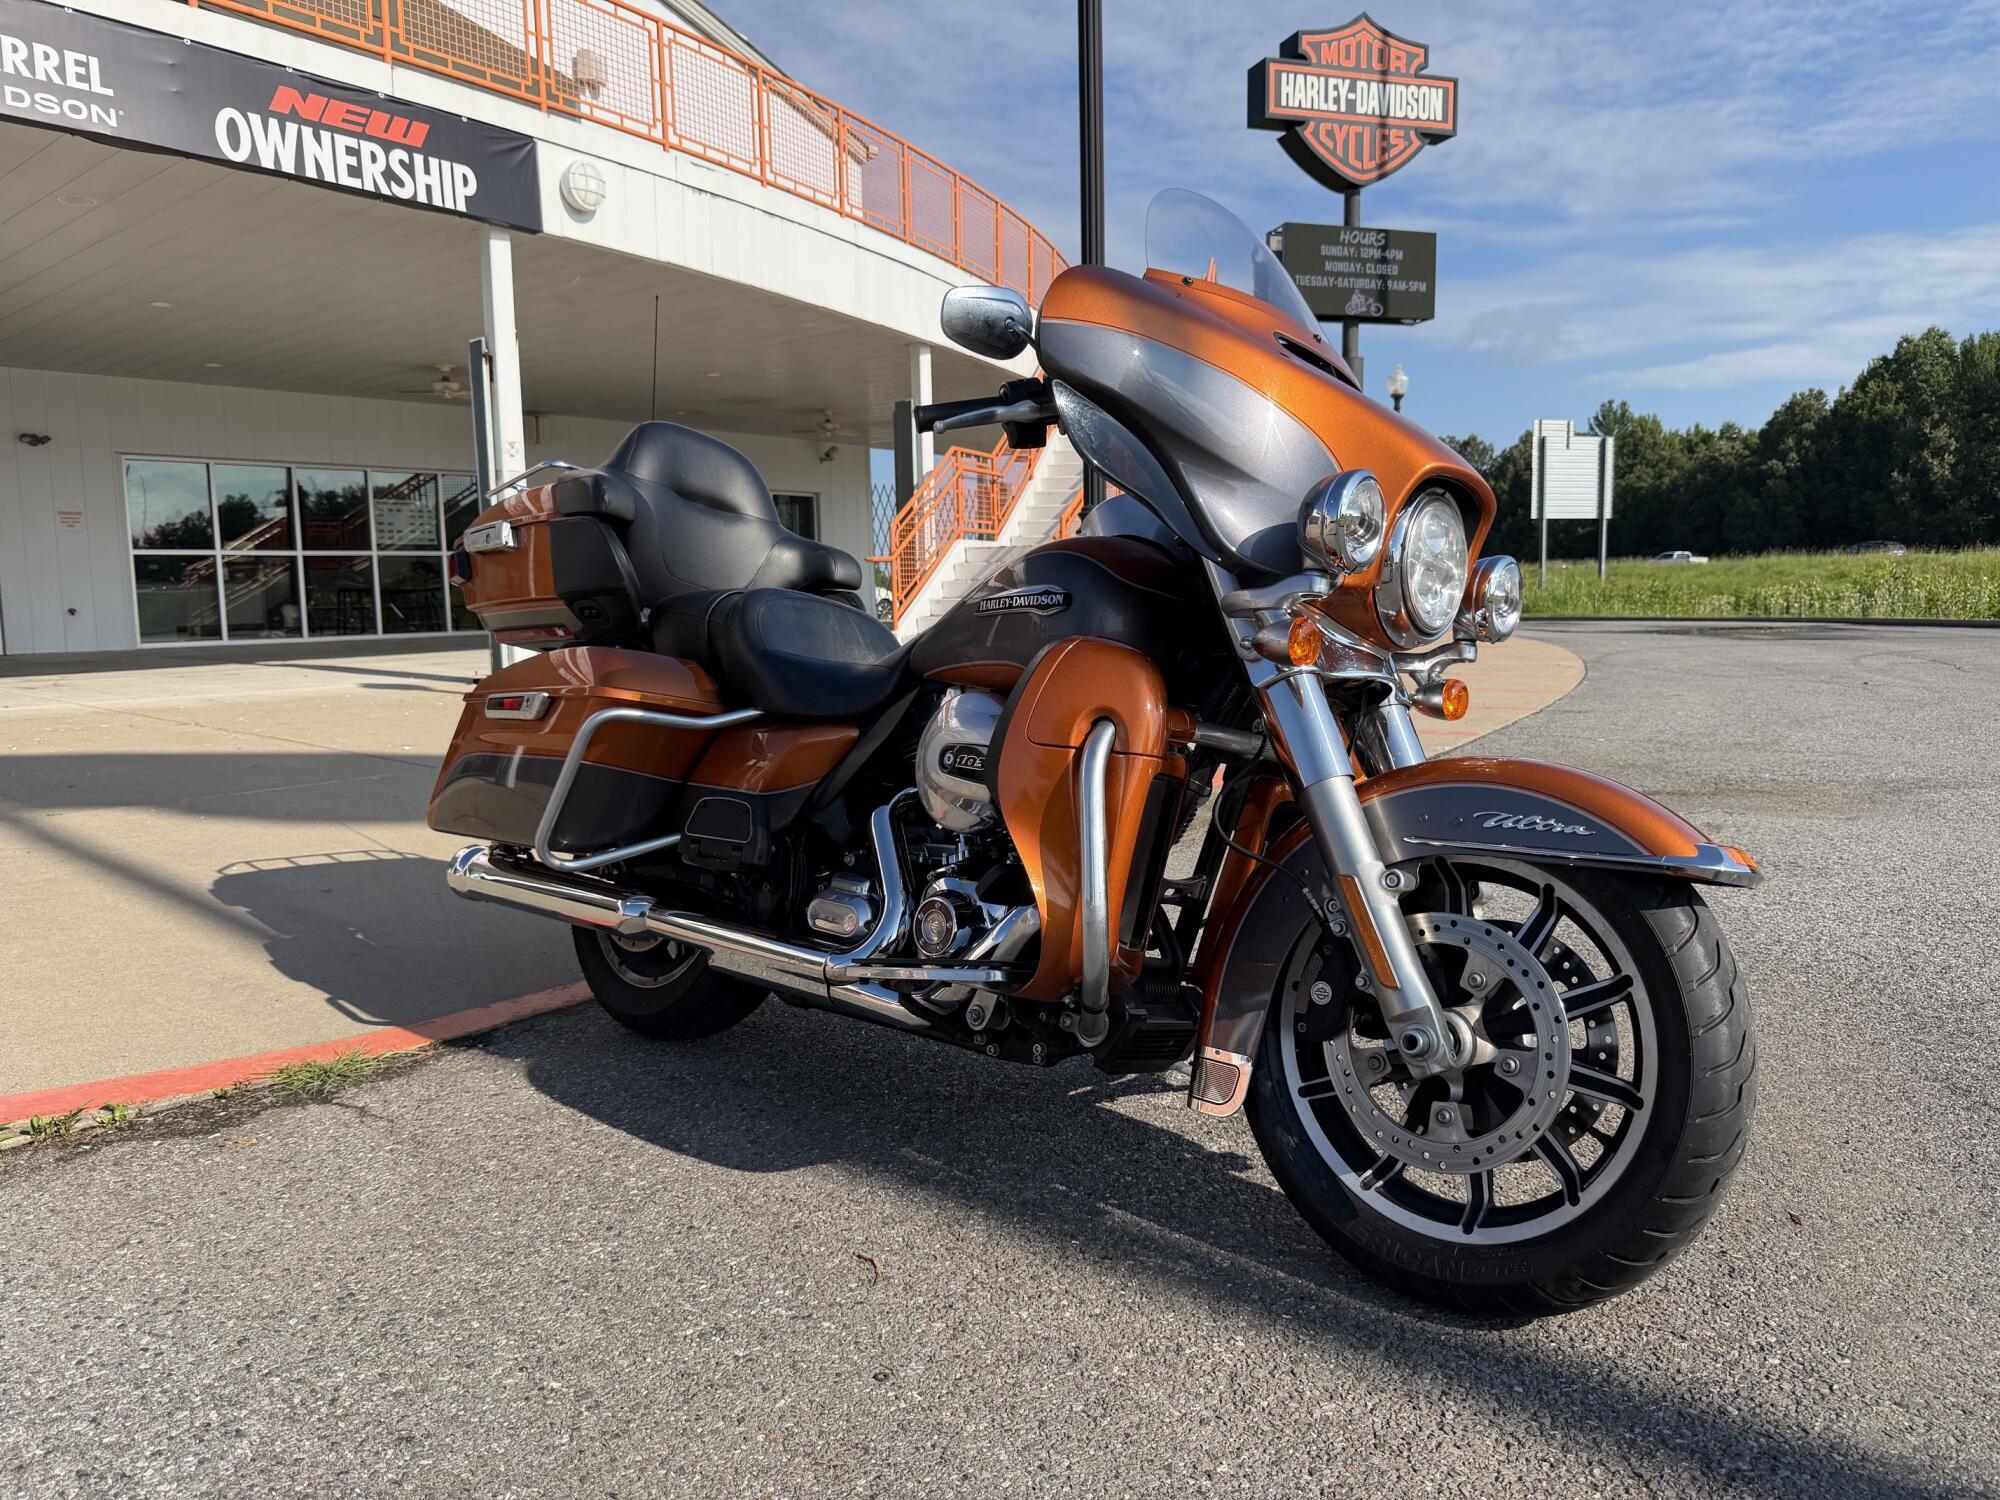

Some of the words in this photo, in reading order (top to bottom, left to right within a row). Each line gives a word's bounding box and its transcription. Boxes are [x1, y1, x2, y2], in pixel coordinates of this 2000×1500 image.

[0, 34, 114, 97] RREL
[1320, 30, 1406, 73] MOTOR
[1280, 71, 1443, 121] HARLEY-DAVIDSON
[268, 85, 430, 148] NEW
[214, 107, 477, 213] OWNERSHIP
[1319, 122, 1406, 170] CYCLES
[1320, 245, 1358, 258] SUNDAY:
[1340, 230, 1387, 247] HOURS
[1324, 261, 1364, 274] MONDAY:
[1365, 263, 1399, 276] CLOSED
[1387, 279, 1427, 293] 9AM-5PM
[980, 594, 1064, 611] HARLEY-DAVIDSON
[1473, 811, 1596, 836] Ultra
